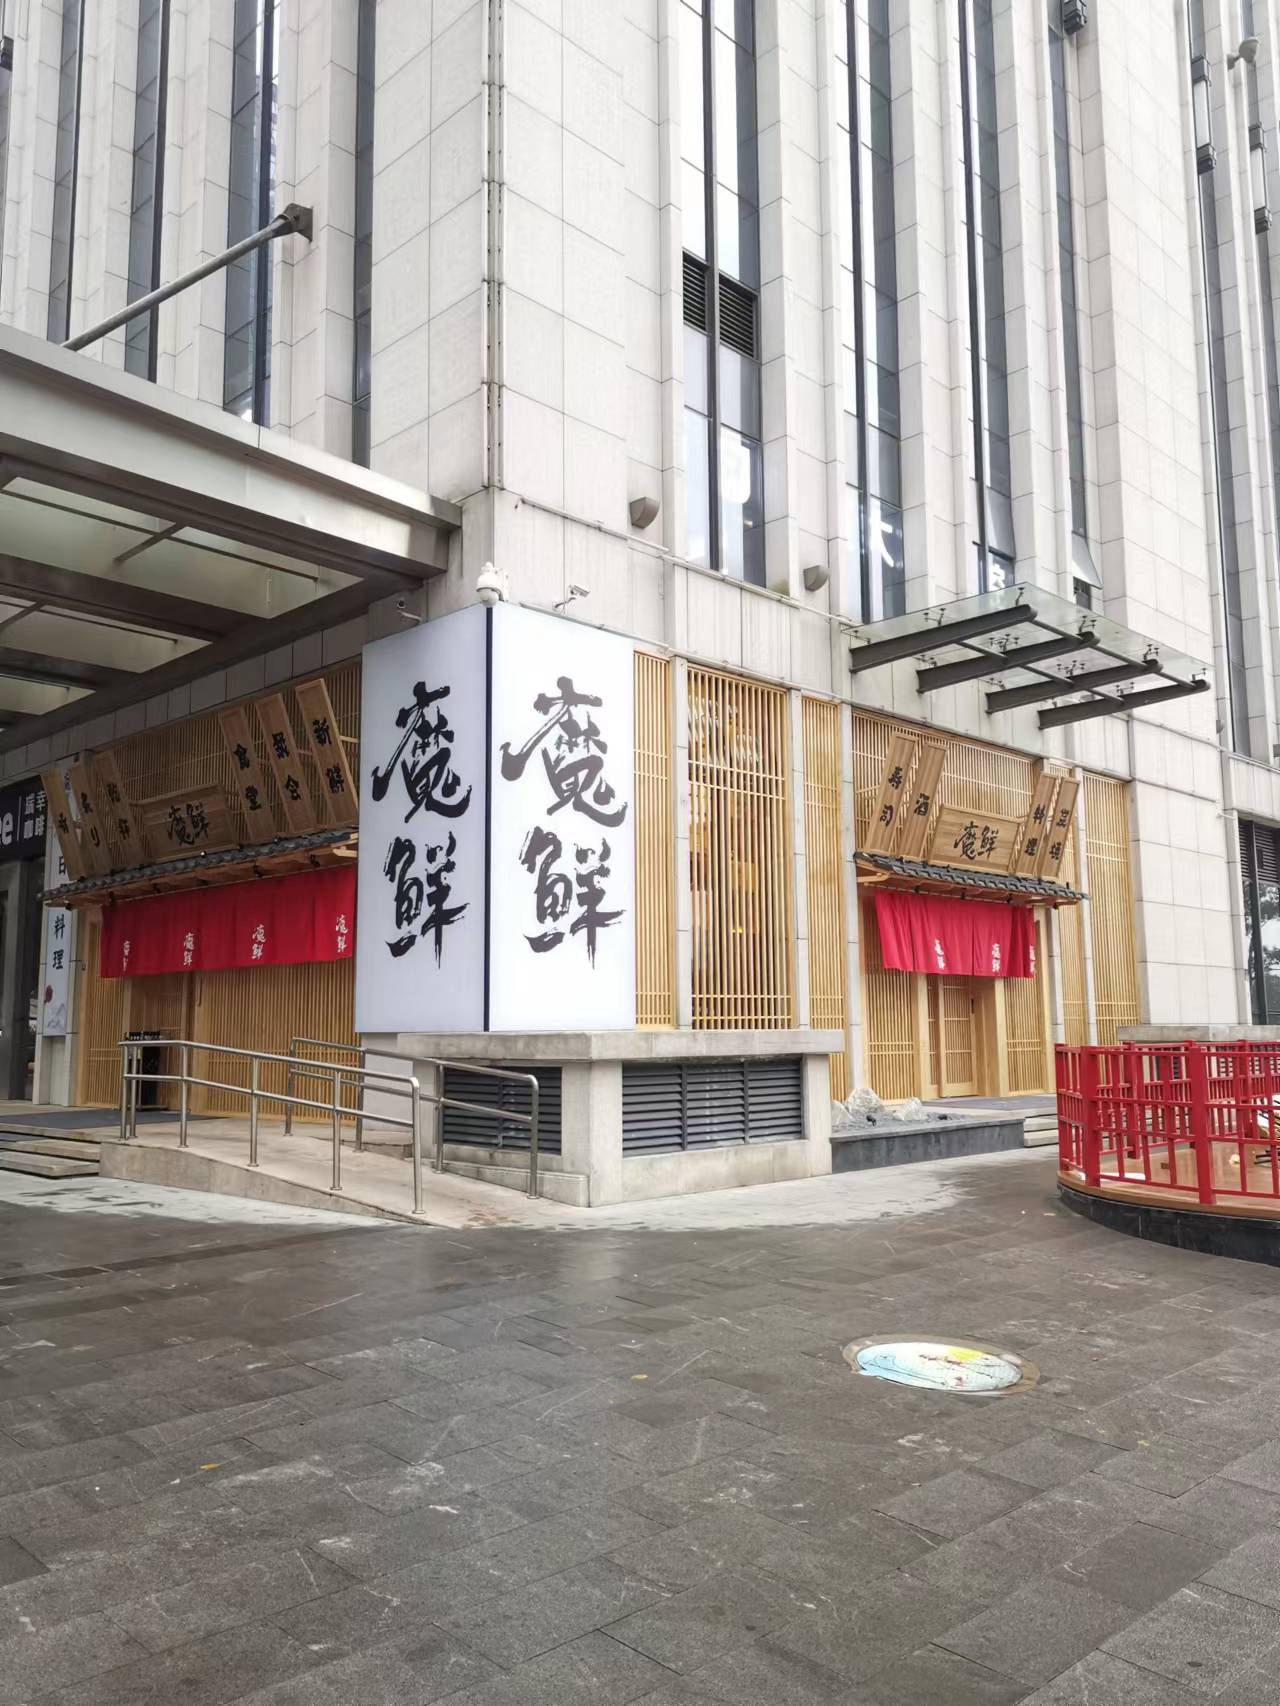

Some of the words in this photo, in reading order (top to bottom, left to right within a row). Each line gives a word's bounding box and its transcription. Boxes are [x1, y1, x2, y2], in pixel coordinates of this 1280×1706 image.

[0, 811, 14, 845] e
[371, 681, 473, 969] 魔鲜
[500, 676, 628, 970] 魔鲜
[953, 820, 999, 860] 魔鲜
[52, 914, 66, 970] 料理
